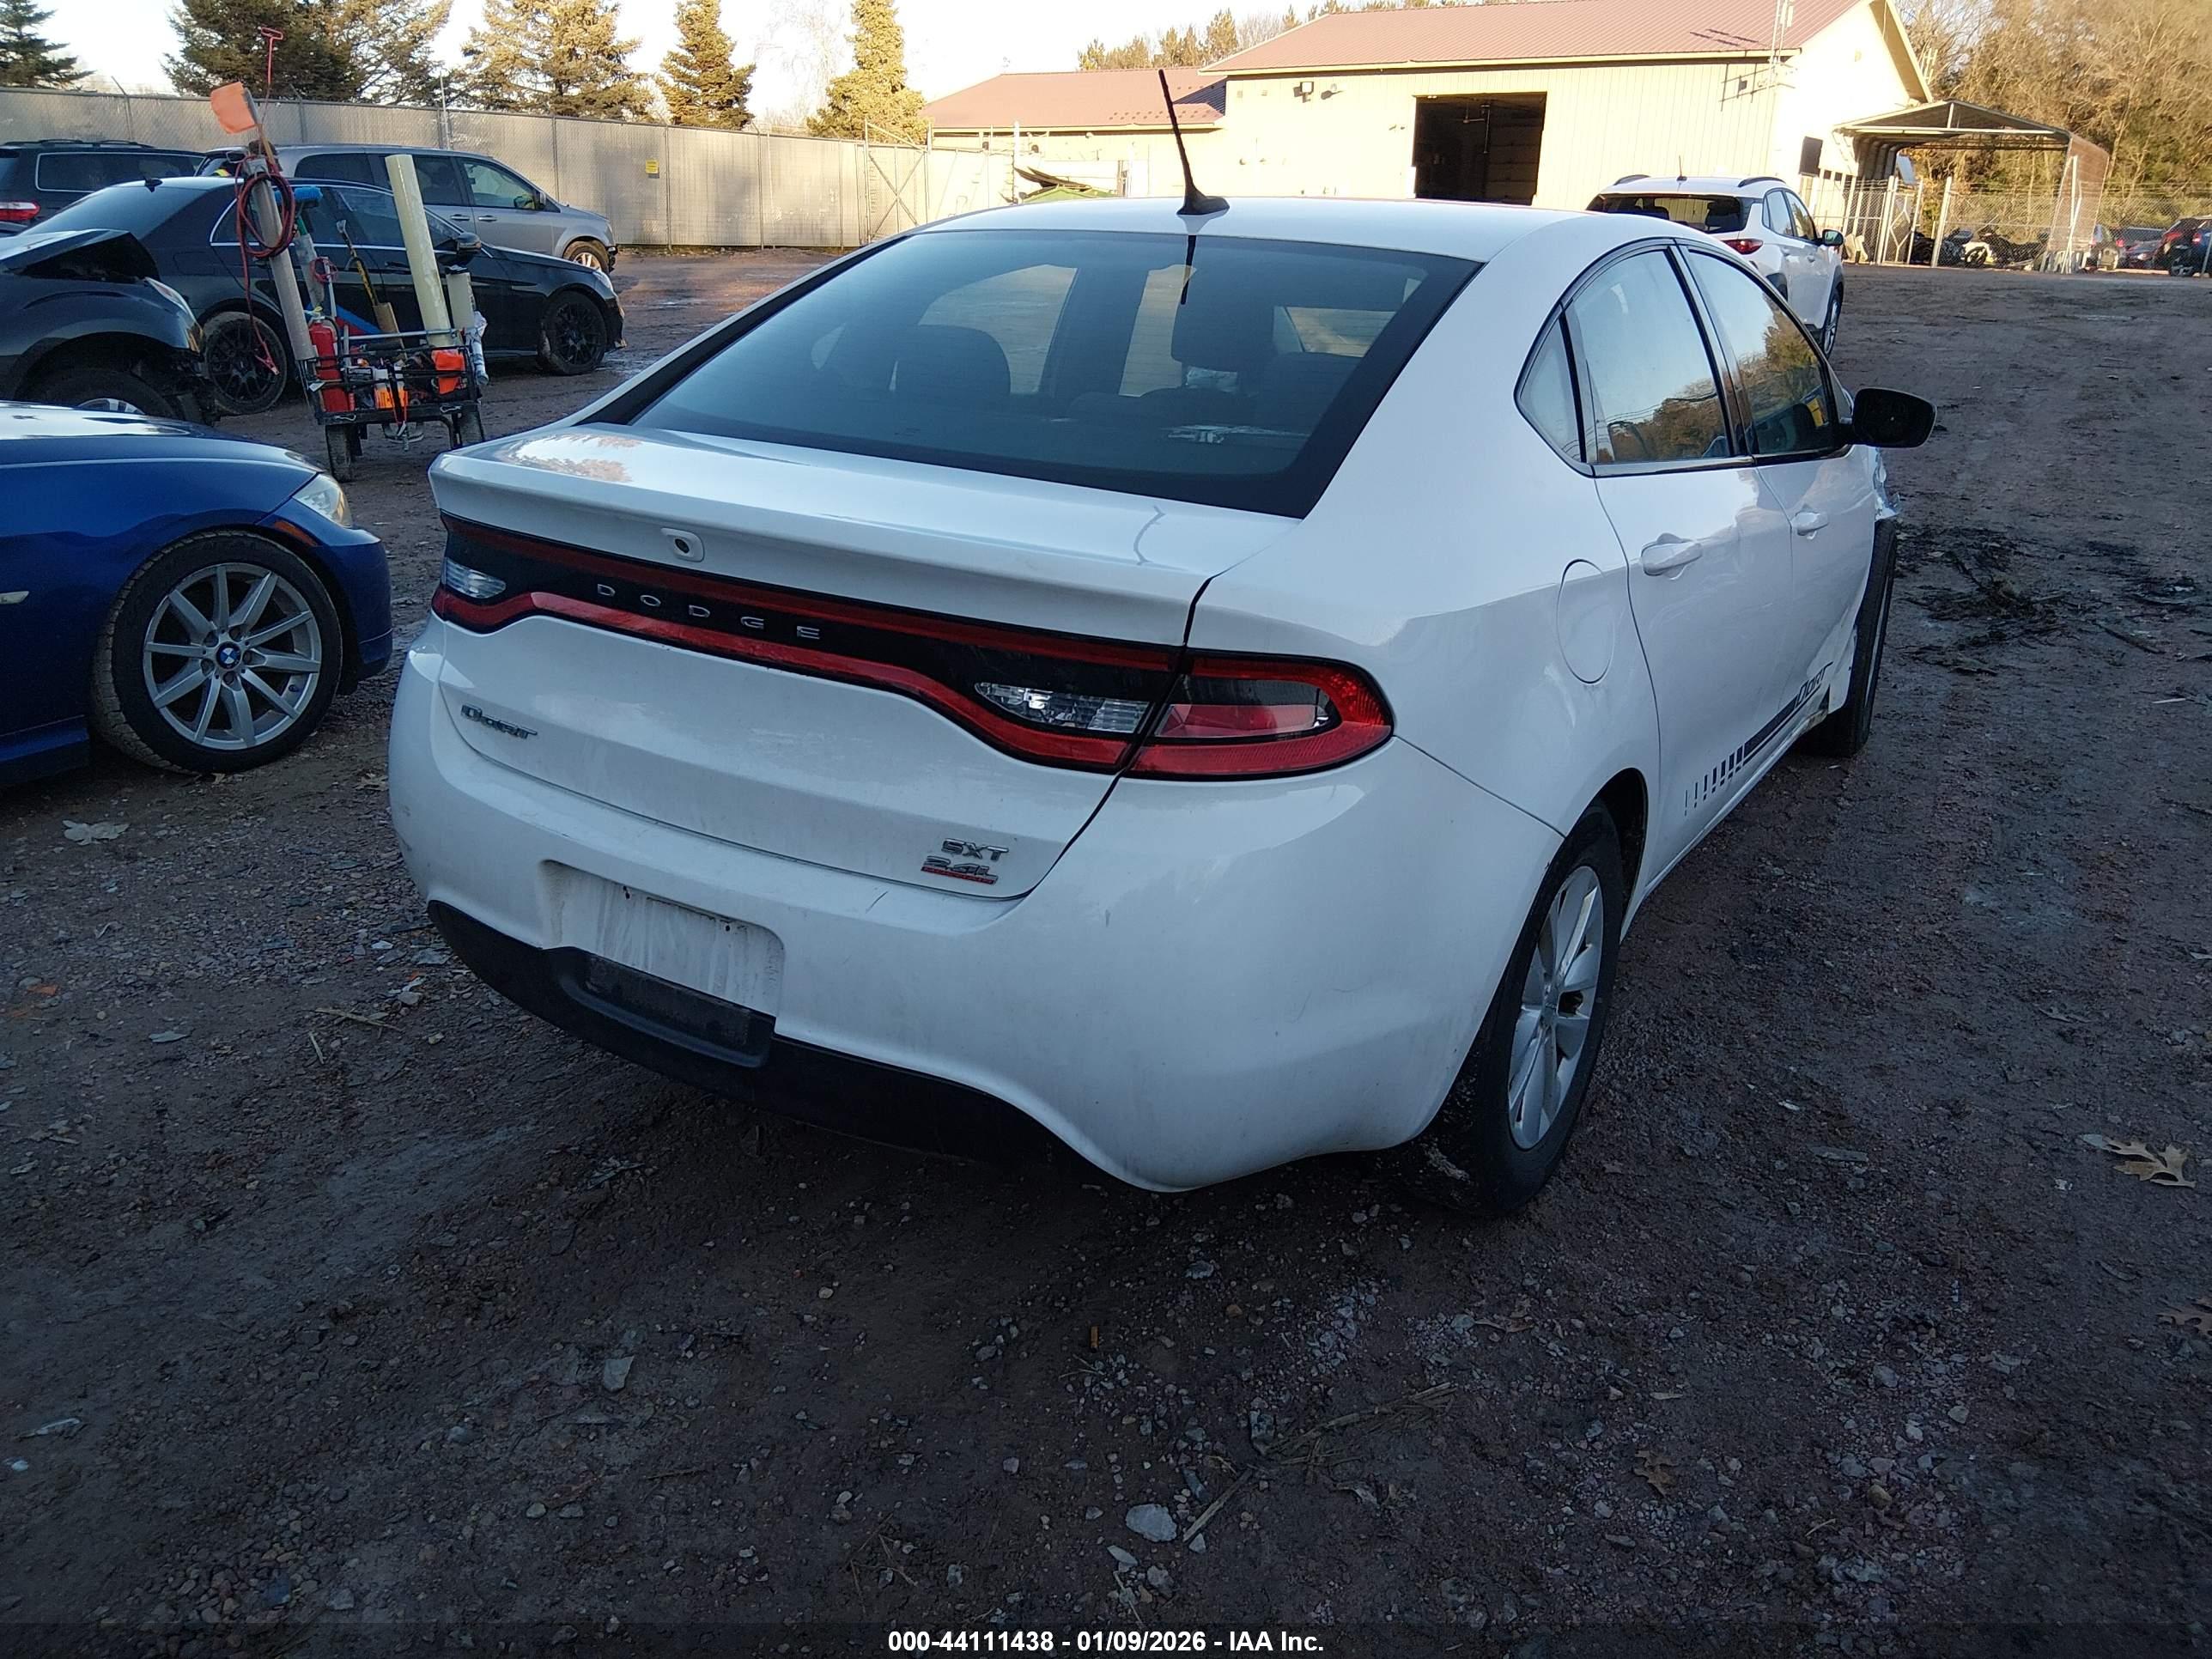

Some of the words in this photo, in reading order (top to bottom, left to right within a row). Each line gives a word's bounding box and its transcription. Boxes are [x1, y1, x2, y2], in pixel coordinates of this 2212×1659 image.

[597, 583, 820, 640] DODGE
[941, 838, 1009, 861] SXT
[924, 855, 999, 881] 2.4L
